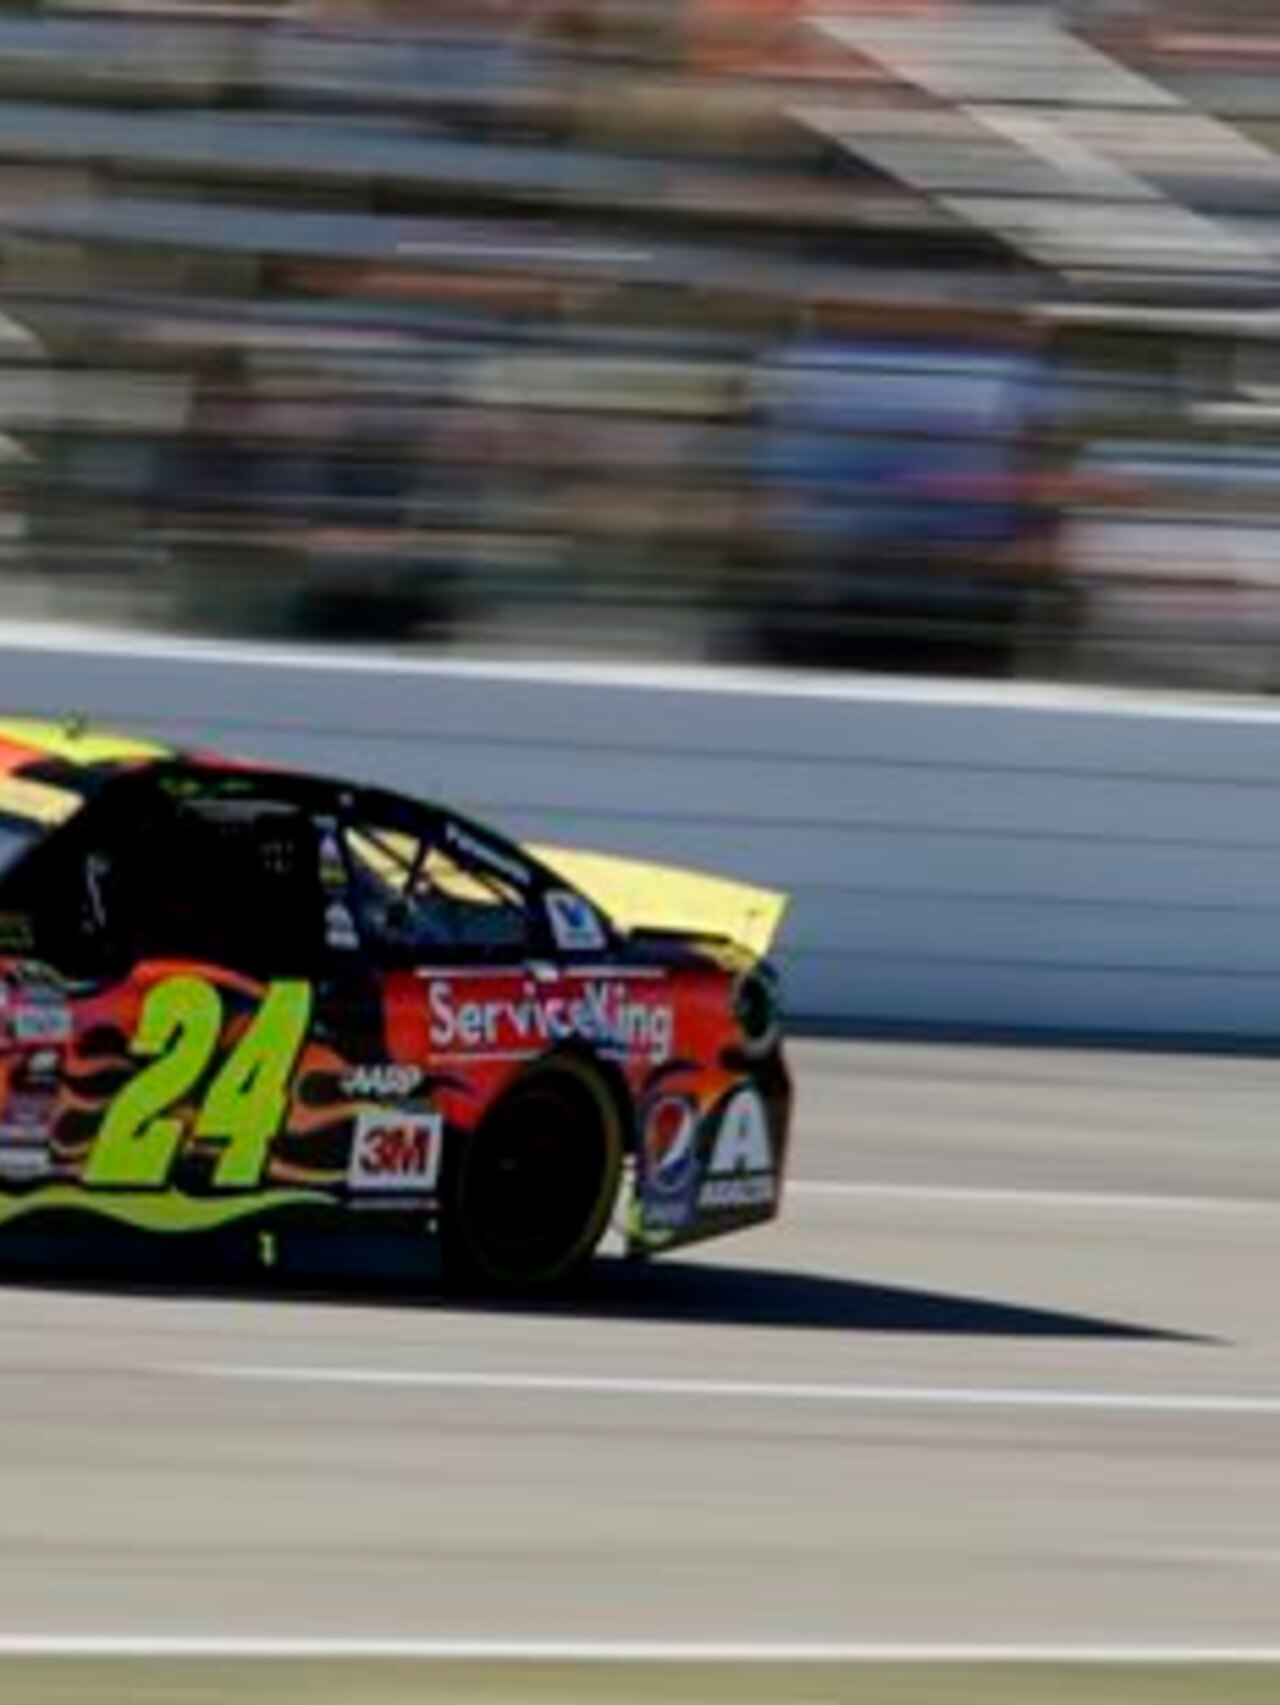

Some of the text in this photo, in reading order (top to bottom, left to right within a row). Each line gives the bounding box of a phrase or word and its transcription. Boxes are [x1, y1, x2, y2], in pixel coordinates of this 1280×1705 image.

[428, 980, 675, 1064] ServiceKing
[83, 976, 312, 1186] 24
[361, 1124, 433, 1176] 3M
